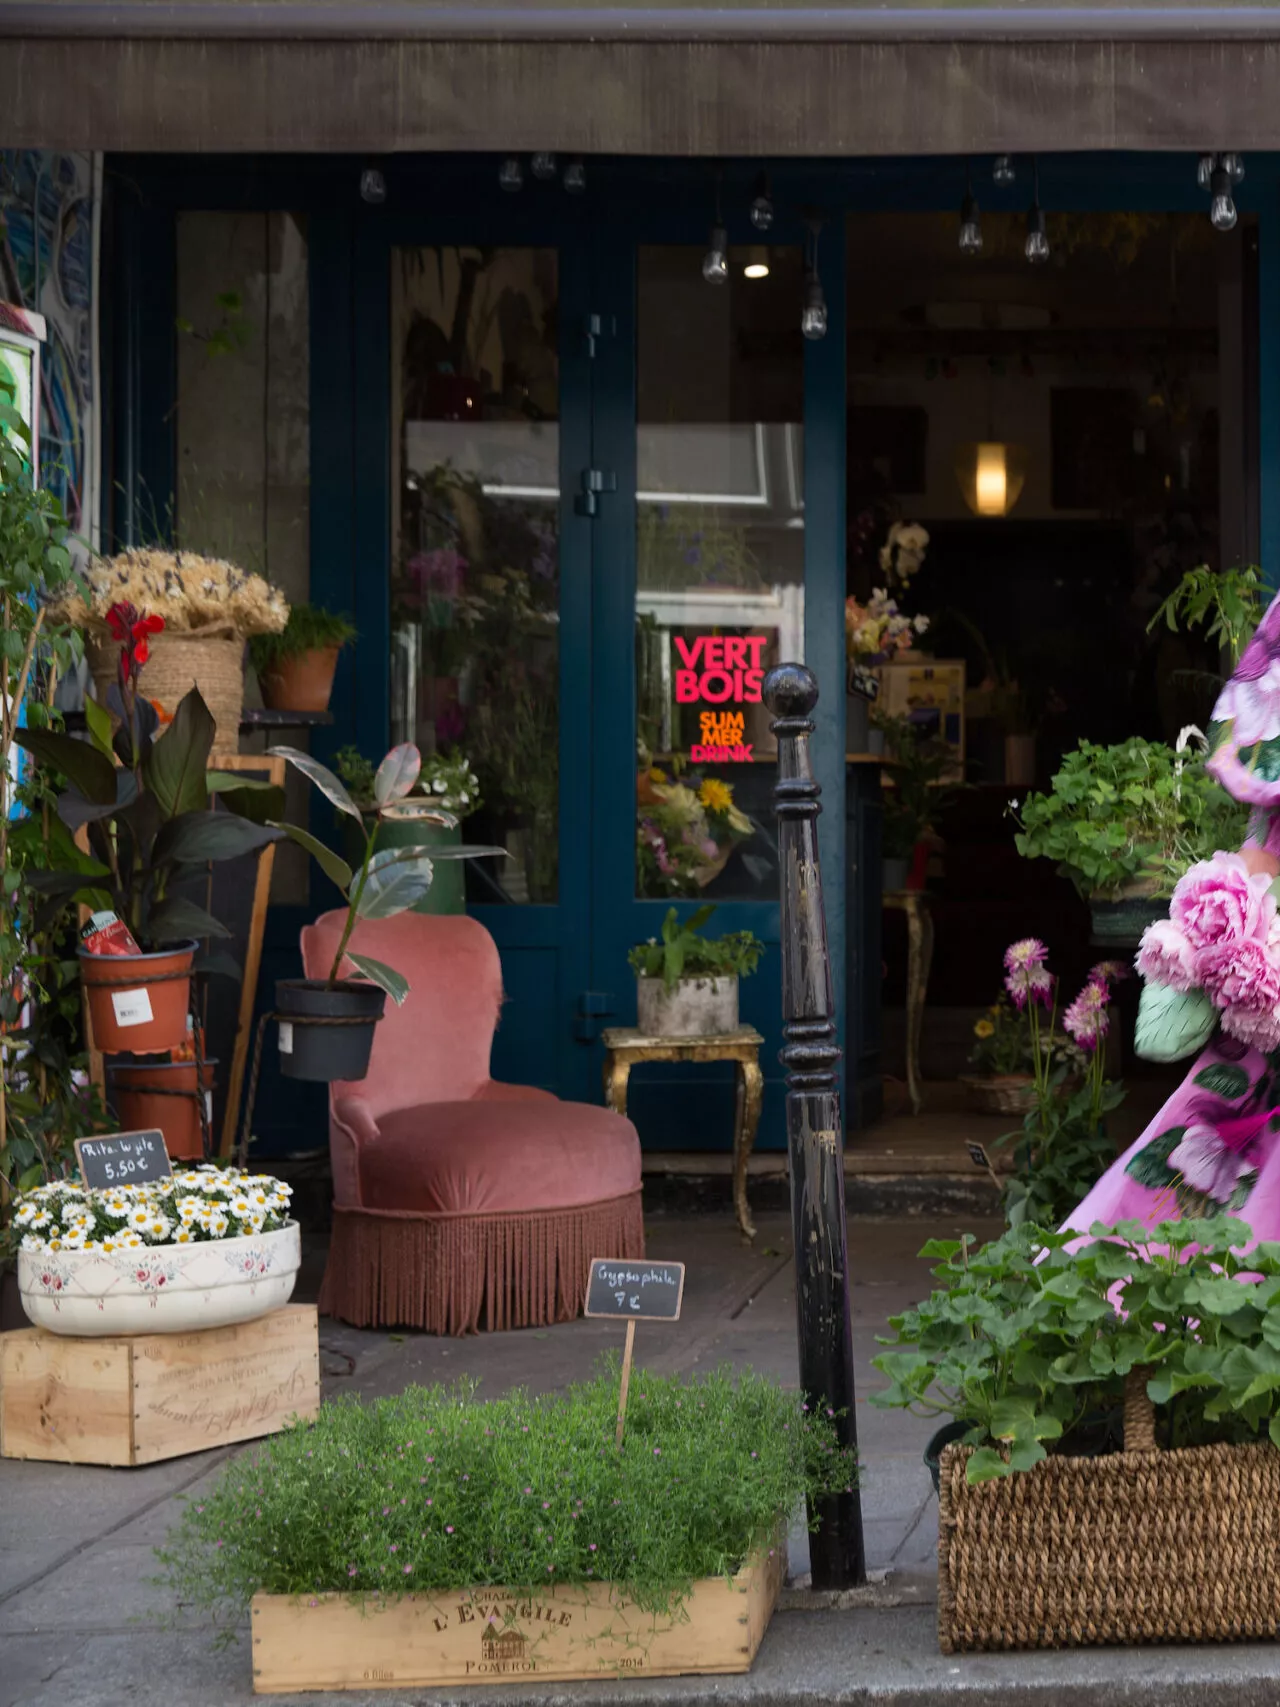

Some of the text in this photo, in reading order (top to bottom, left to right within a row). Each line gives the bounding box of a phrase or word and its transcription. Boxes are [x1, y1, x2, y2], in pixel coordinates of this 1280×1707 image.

[674, 636, 767, 670] VERT
[675, 669, 765, 704] BOIS
[700, 711, 745, 730] SUM
[701, 729, 744, 746] MER
[691, 744, 754, 762] DRINK
[466, 1660, 539, 1674] POMEROL
